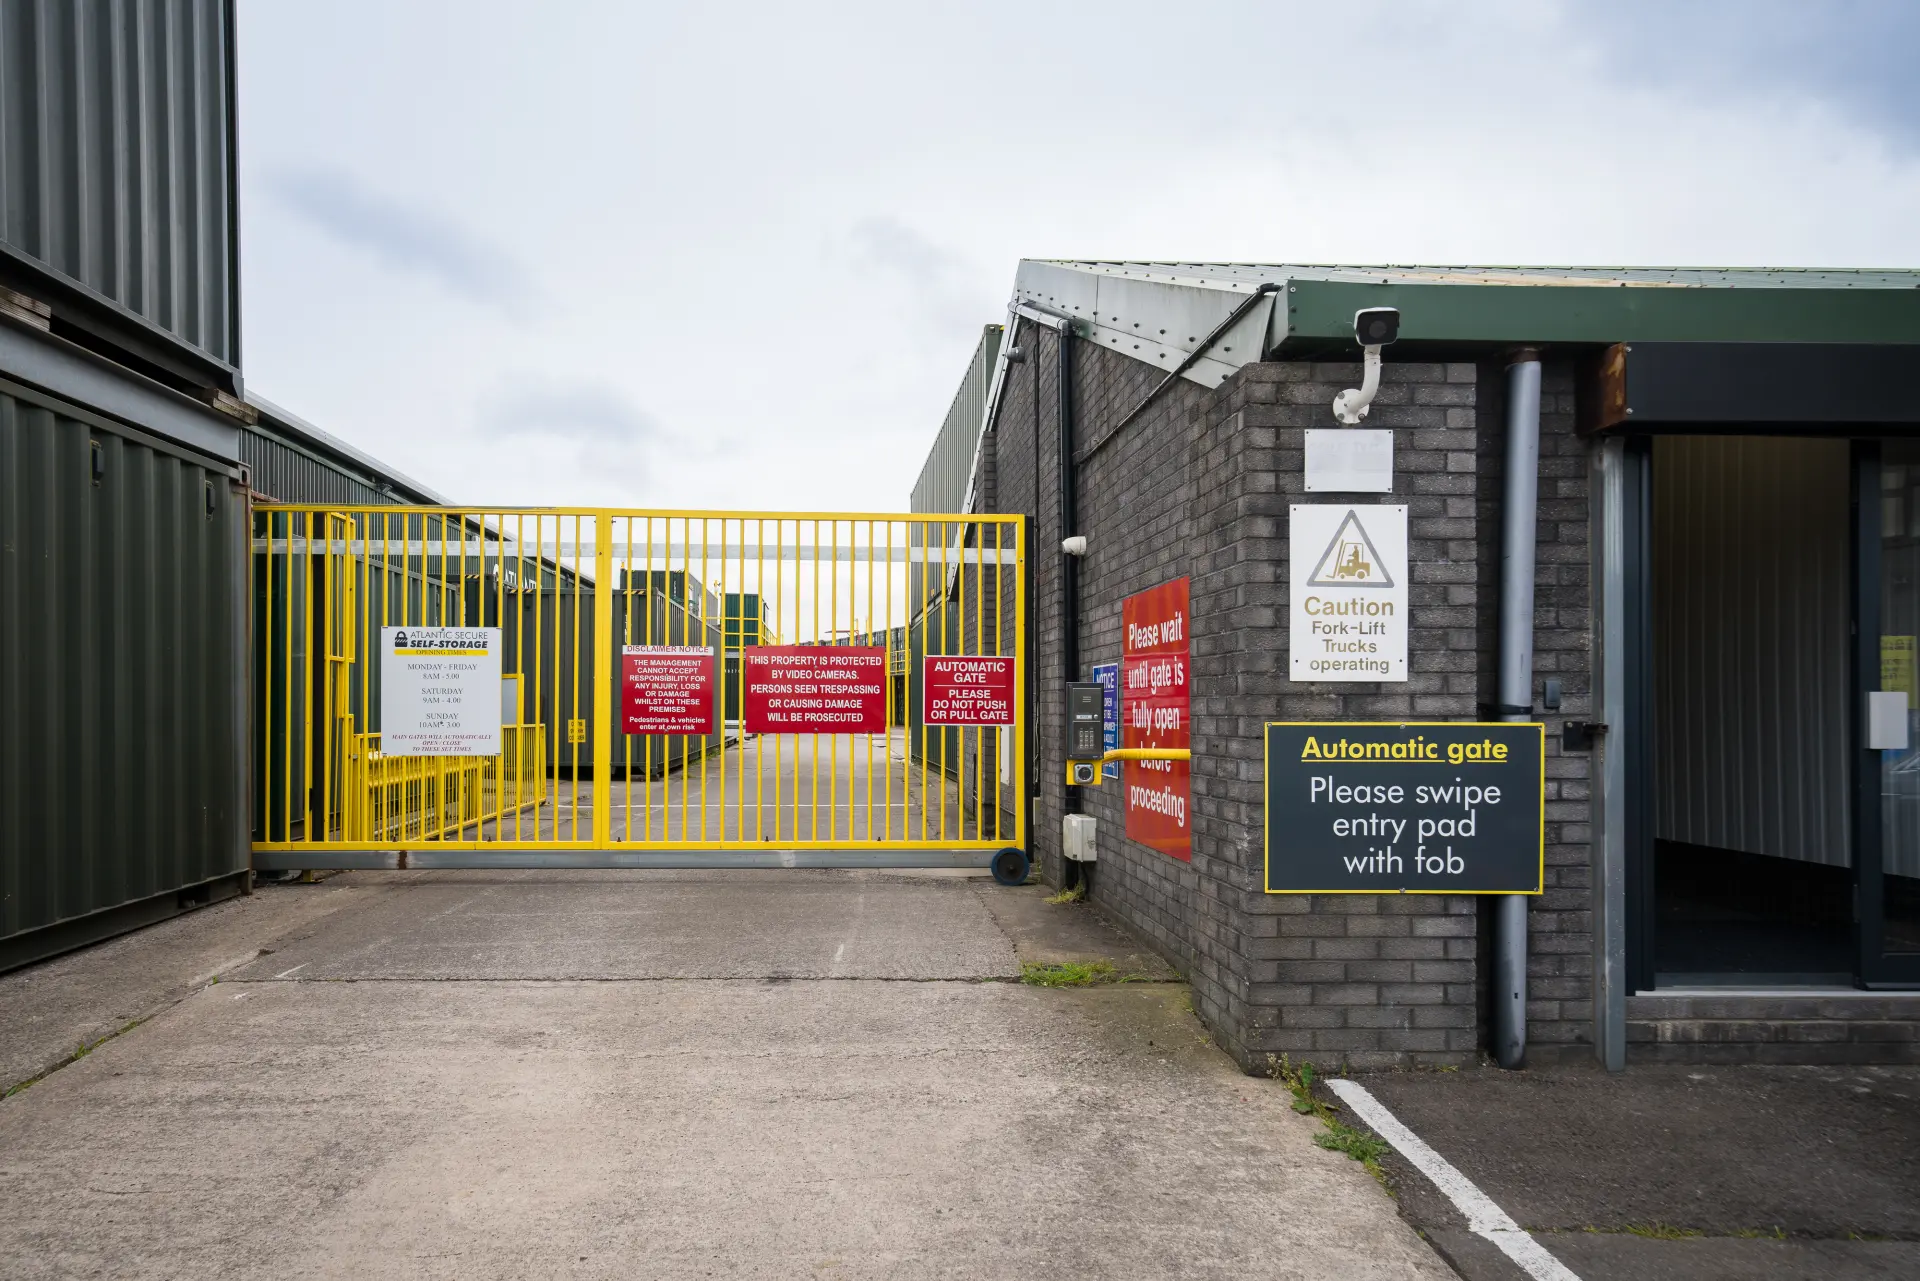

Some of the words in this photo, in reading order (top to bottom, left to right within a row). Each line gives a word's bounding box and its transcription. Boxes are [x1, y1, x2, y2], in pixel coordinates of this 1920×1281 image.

[1304, 596, 1394, 616] Caution
[1129, 623, 1158, 650] Please
[1161, 611, 1182, 643] wait
[1312, 621, 1386, 635] Fork-Lift
[410, 631, 452, 639] ATLANTIC
[410, 640, 488, 648] SELF-STORAGE
[1322, 639, 1377, 653] Trucks
[749, 656, 768, 664] THIS
[771, 656, 817, 665] PROPERTY
[820, 657, 828, 665] IS
[830, 657, 882, 665] PROTECTED
[1310, 657, 1389, 674] operating
[935, 662, 1005, 672] AUTOMATIC
[772, 670, 784, 679] BY
[786, 670, 812, 679] VIDEO
[815, 670, 859, 679] CAMERAS.
[954, 673, 986, 683] GATE
[1129, 660, 1148, 689] until
[1151, 659, 1171, 695] gate
[1174, 656, 1184, 686] is
[751, 684, 792, 693] PERSONS
[794, 685, 817, 693] SEEN
[820, 685, 880, 694] TRESPASSING
[949, 690, 991, 698] PLEASE
[769, 699, 781, 708] OR
[784, 699, 822, 708] CAUSING
[825, 700, 862, 708] DAMAGE
[933, 700, 949, 708] DO
[952, 700, 974, 709] NOT
[977, 700, 1006, 709] PUSH
[768, 712, 788, 721] WILL
[791, 713, 802, 721] BE
[805, 713, 863, 722] PROSECUTED
[931, 710, 946, 719] OR
[950, 710, 977, 719] PULL
[980, 711, 1008, 720] GATE
[1132, 701, 1152, 736] fully
[1155, 707, 1179, 736] open
[1301, 736, 1438, 759] Automatic
[1447, 739, 1508, 764] gate
[1310, 775, 1404, 804] Please
[1415, 777, 1501, 811] swipe
[1131, 785, 1184, 828] proceeding
[1333, 813, 1406, 844] entry
[1418, 809, 1476, 844] pad
[1343, 846, 1403, 873] with
[1415, 846, 1465, 875] fob
